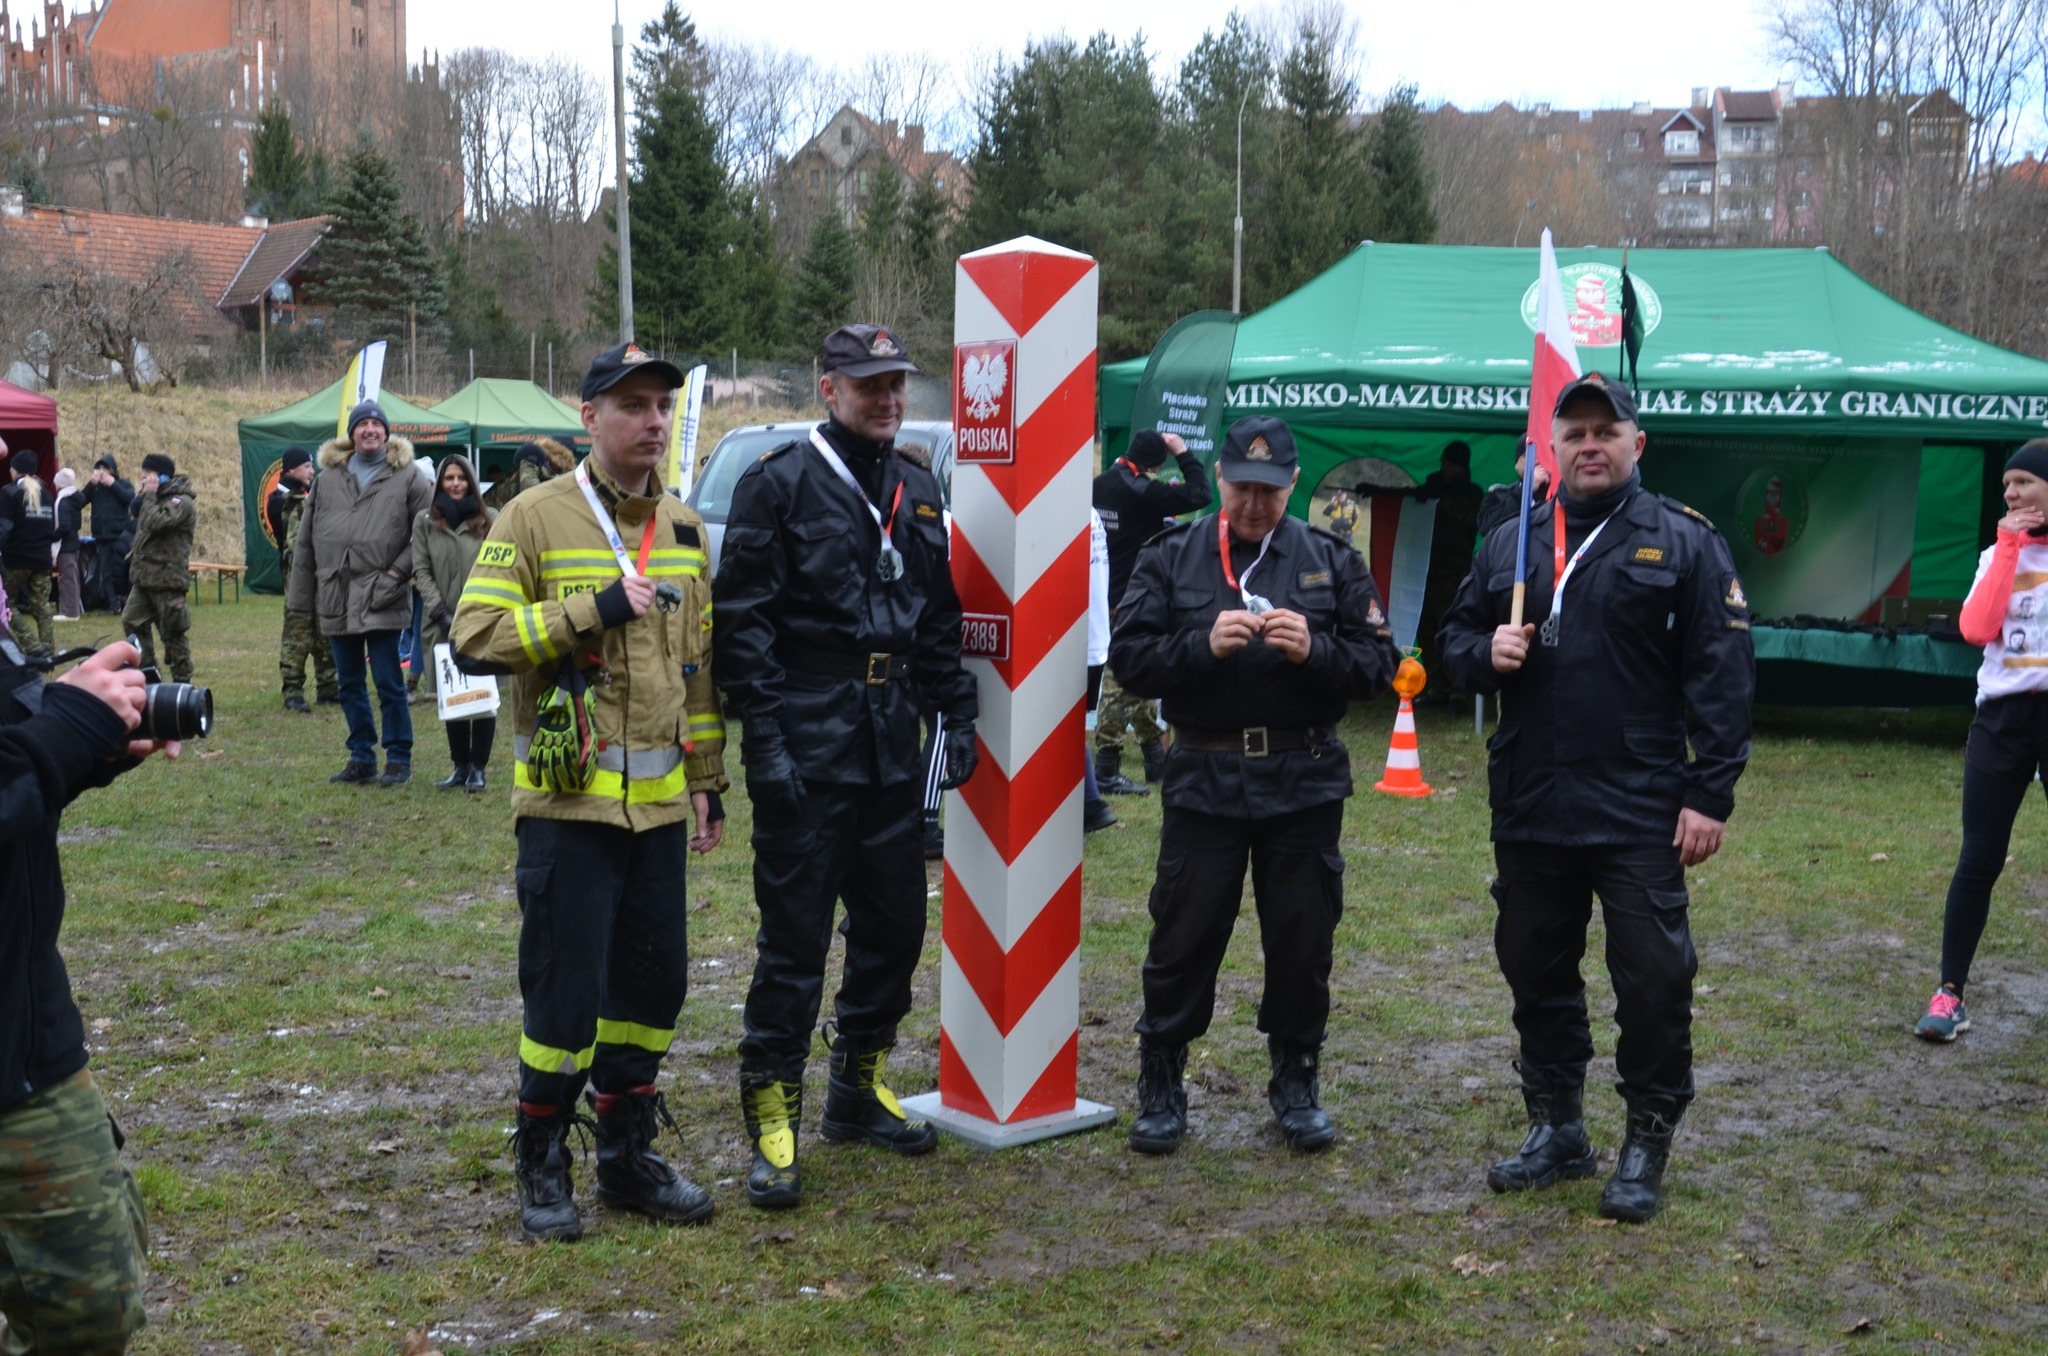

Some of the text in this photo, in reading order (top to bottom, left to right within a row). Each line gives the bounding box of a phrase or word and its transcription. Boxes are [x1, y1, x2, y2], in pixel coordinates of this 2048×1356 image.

[1162, 391, 1208, 409] Placówka
[1700, 384, 1832, 416] STRAŻY
[1168, 407, 1198, 423] Straży
[1156, 420, 1206, 438] Granicznej
[960, 427, 1008, 452] POLSKA
[482, 546, 512, 561] PSP
[961, 620, 998, 653] 2389
